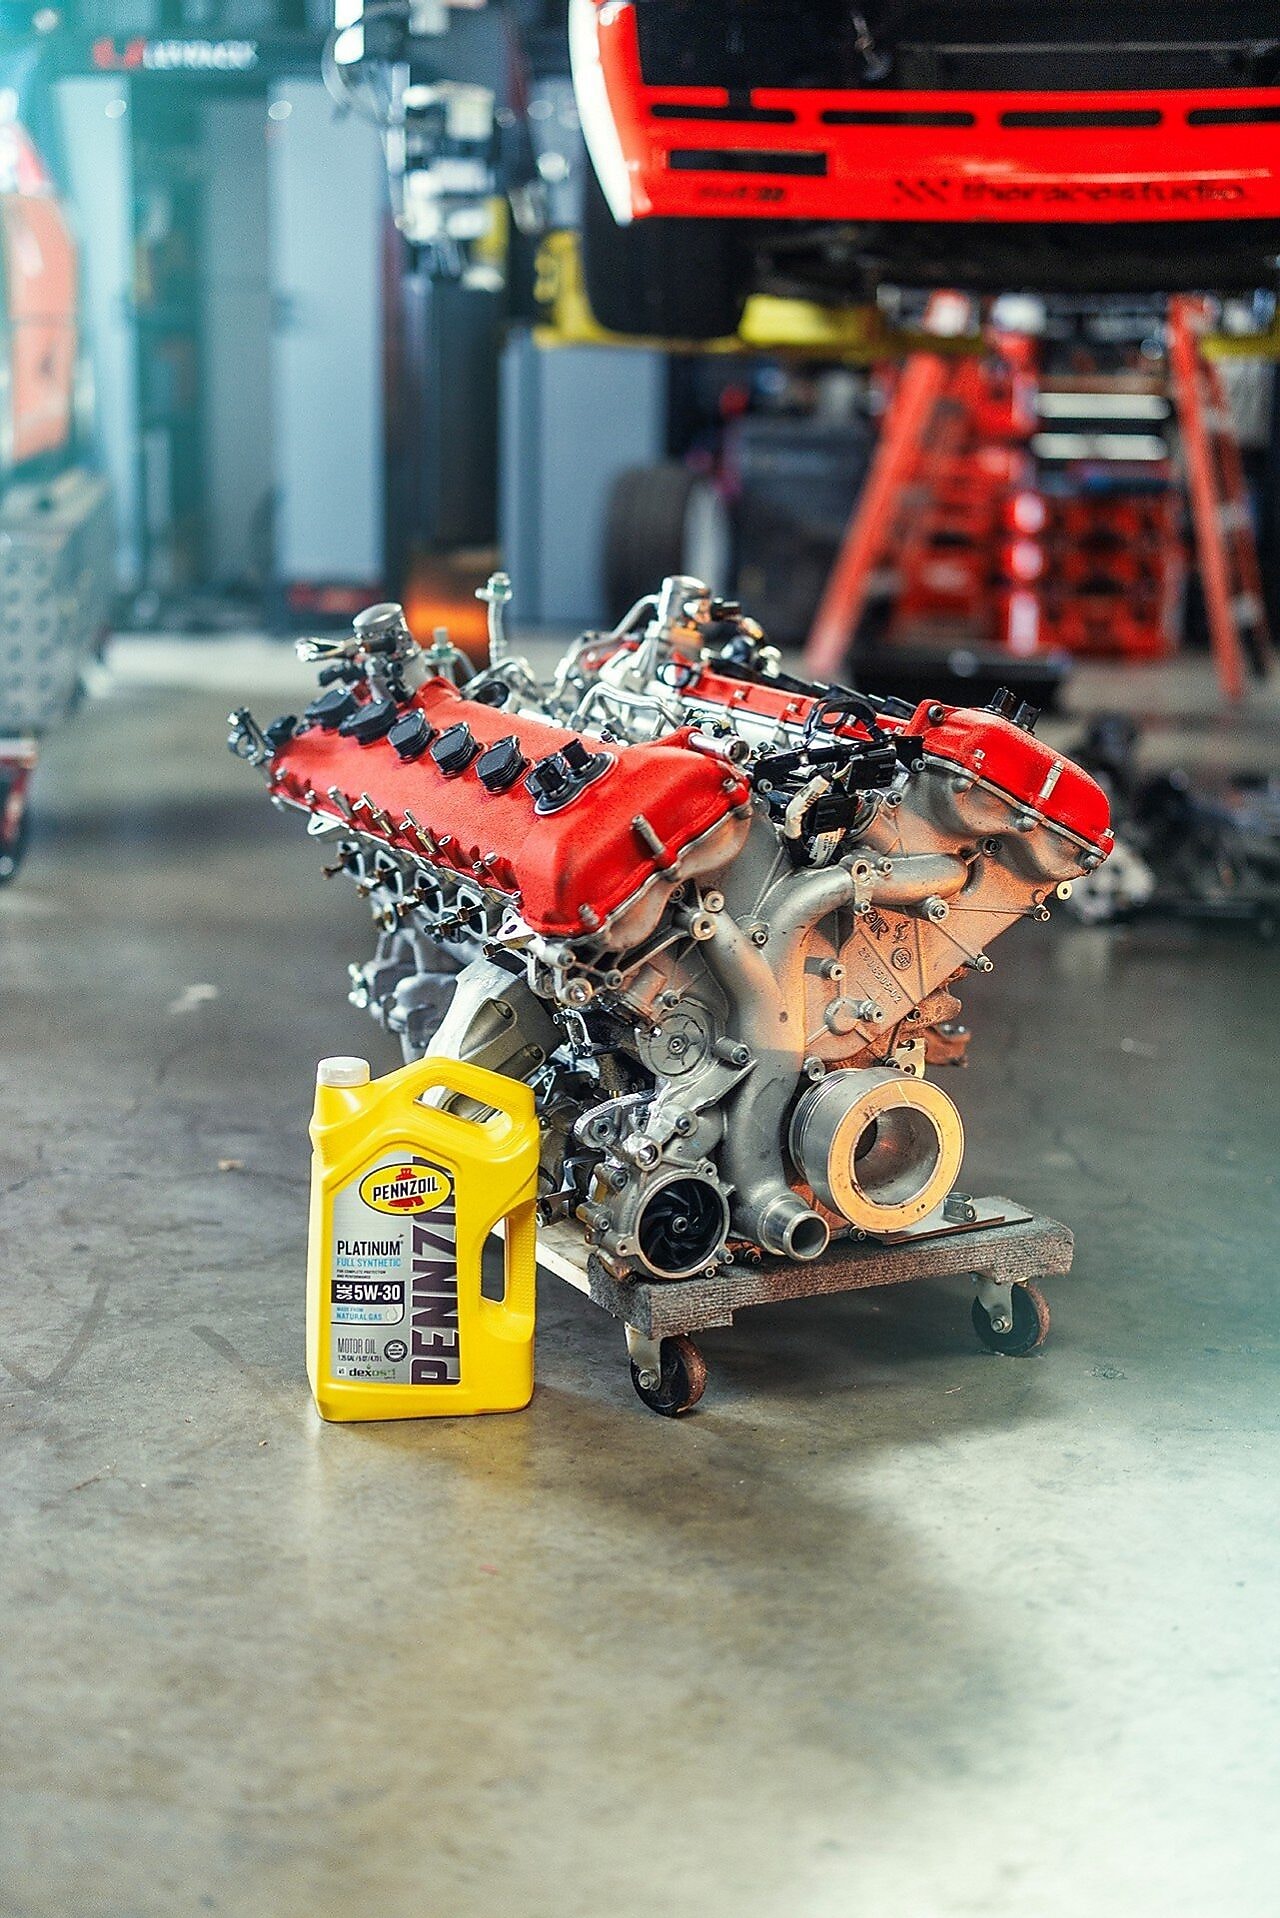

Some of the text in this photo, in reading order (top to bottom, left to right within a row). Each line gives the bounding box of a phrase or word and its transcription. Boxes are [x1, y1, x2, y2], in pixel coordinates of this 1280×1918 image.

[373, 1176, 438, 1202] PENNZOIL
[337, 1240, 401, 1256] PLATINUM
[337, 1258, 401, 1267] FULL SYNTHETIC
[336, 1284, 401, 1301] SAE 5W-30
[368, 1313, 383, 1321] GAS
[337, 1338, 363, 1354] MOTOR
[365, 1338, 377, 1354] OIL
